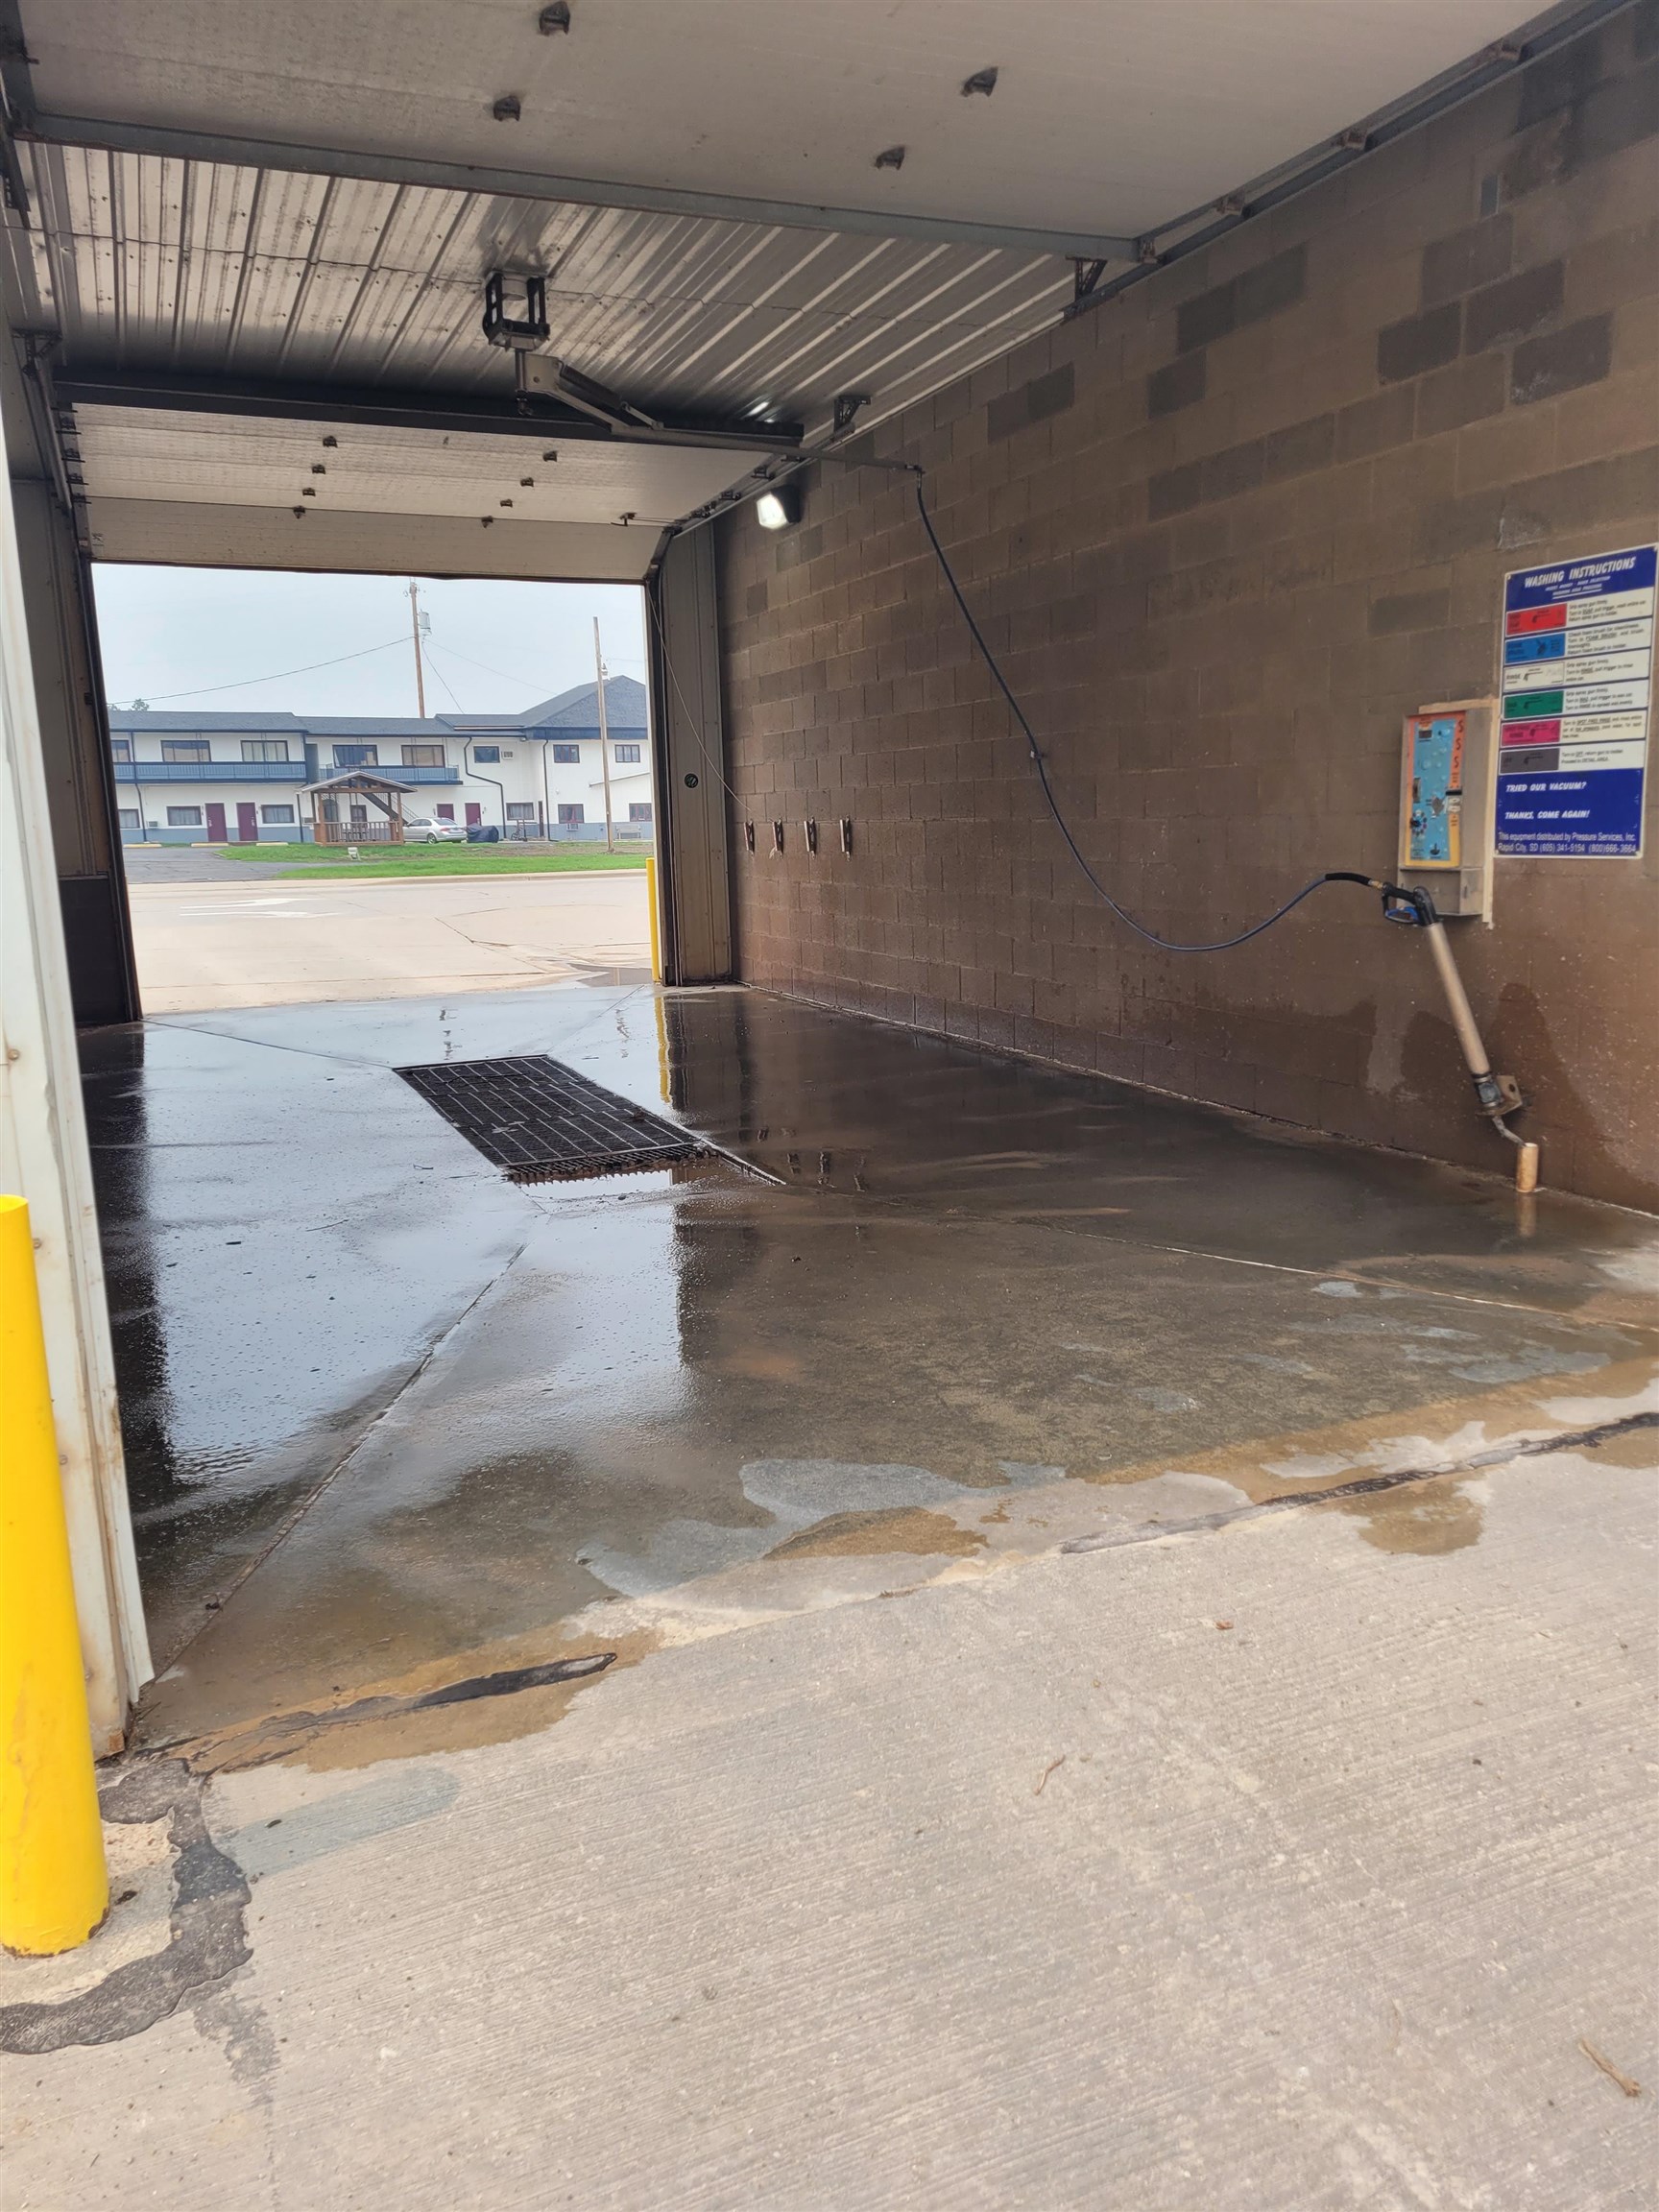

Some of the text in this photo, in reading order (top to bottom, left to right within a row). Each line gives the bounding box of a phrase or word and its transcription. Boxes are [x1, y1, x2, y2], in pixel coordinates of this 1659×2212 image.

[1525, 571, 1565, 588] WASHING
[1569, 557, 1636, 580] INSTRUCTIONS
[1550, 781, 1587, 790] VACUUM?
[1504, 811, 1534, 820] THANKS,
[1561, 809, 1590, 818] AGAIN!
[1499, 831, 1508, 840] This
[1509, 832, 1536, 842] equipment
[1565, 832, 1572, 842] by
[1572, 832, 1597, 841] Pressure
[1598, 832, 1624, 842] Services,
[1625, 832, 1636, 841] Inc.
[1498, 843, 1514, 853] Rapid
[1529, 843, 1539, 852] SD
